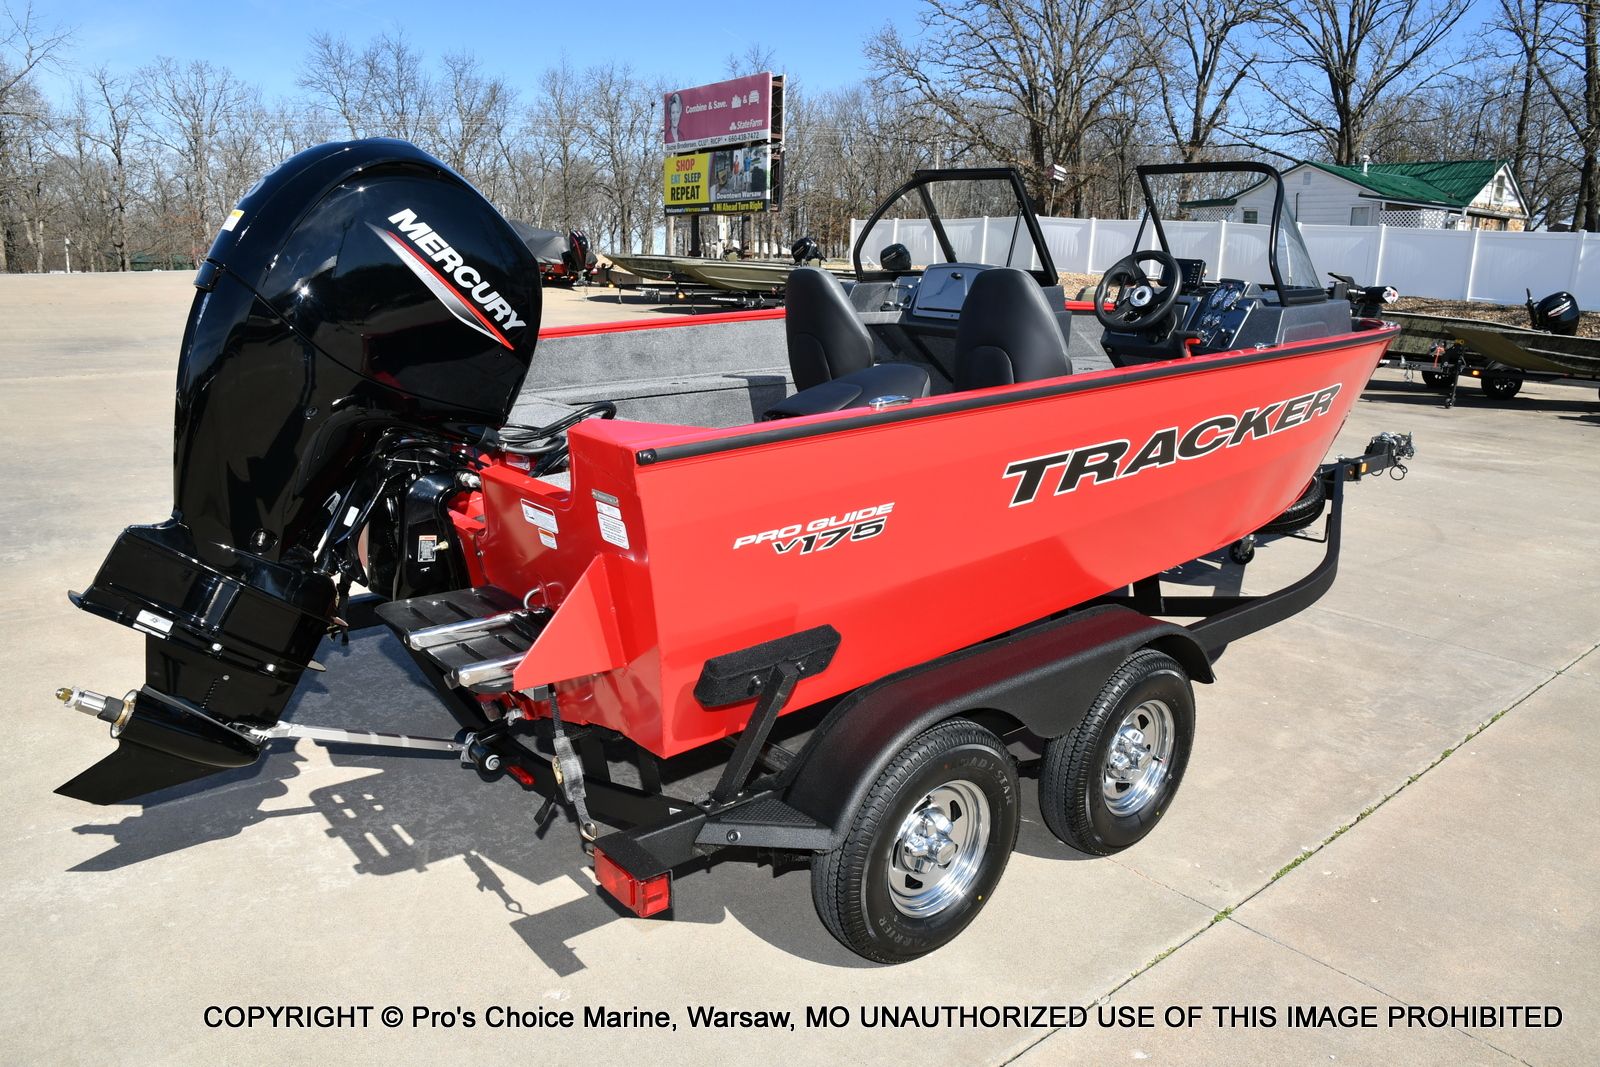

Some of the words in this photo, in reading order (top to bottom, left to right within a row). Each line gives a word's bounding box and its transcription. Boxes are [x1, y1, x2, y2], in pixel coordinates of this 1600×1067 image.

[685, 103, 707, 114] Combine
[708, 101, 713, 111] &
[713, 101, 728, 110] Save.
[676, 158, 695, 172] SHOP
[671, 173, 681, 184] EAT
[684, 172, 701, 183] SLEEP
[670, 185, 700, 201] REPEAT
[716, 192, 742, 200] Downtown
[723, 202, 737, 211] Ahead
[738, 202, 749, 211] Turn
[750, 201, 763, 212] Right
[388, 208, 526, 330] MERCURY
[1002, 383, 1342, 507] TRACKER
[733, 524, 802, 549] PRO
[806, 502, 895, 532] GUIDE
